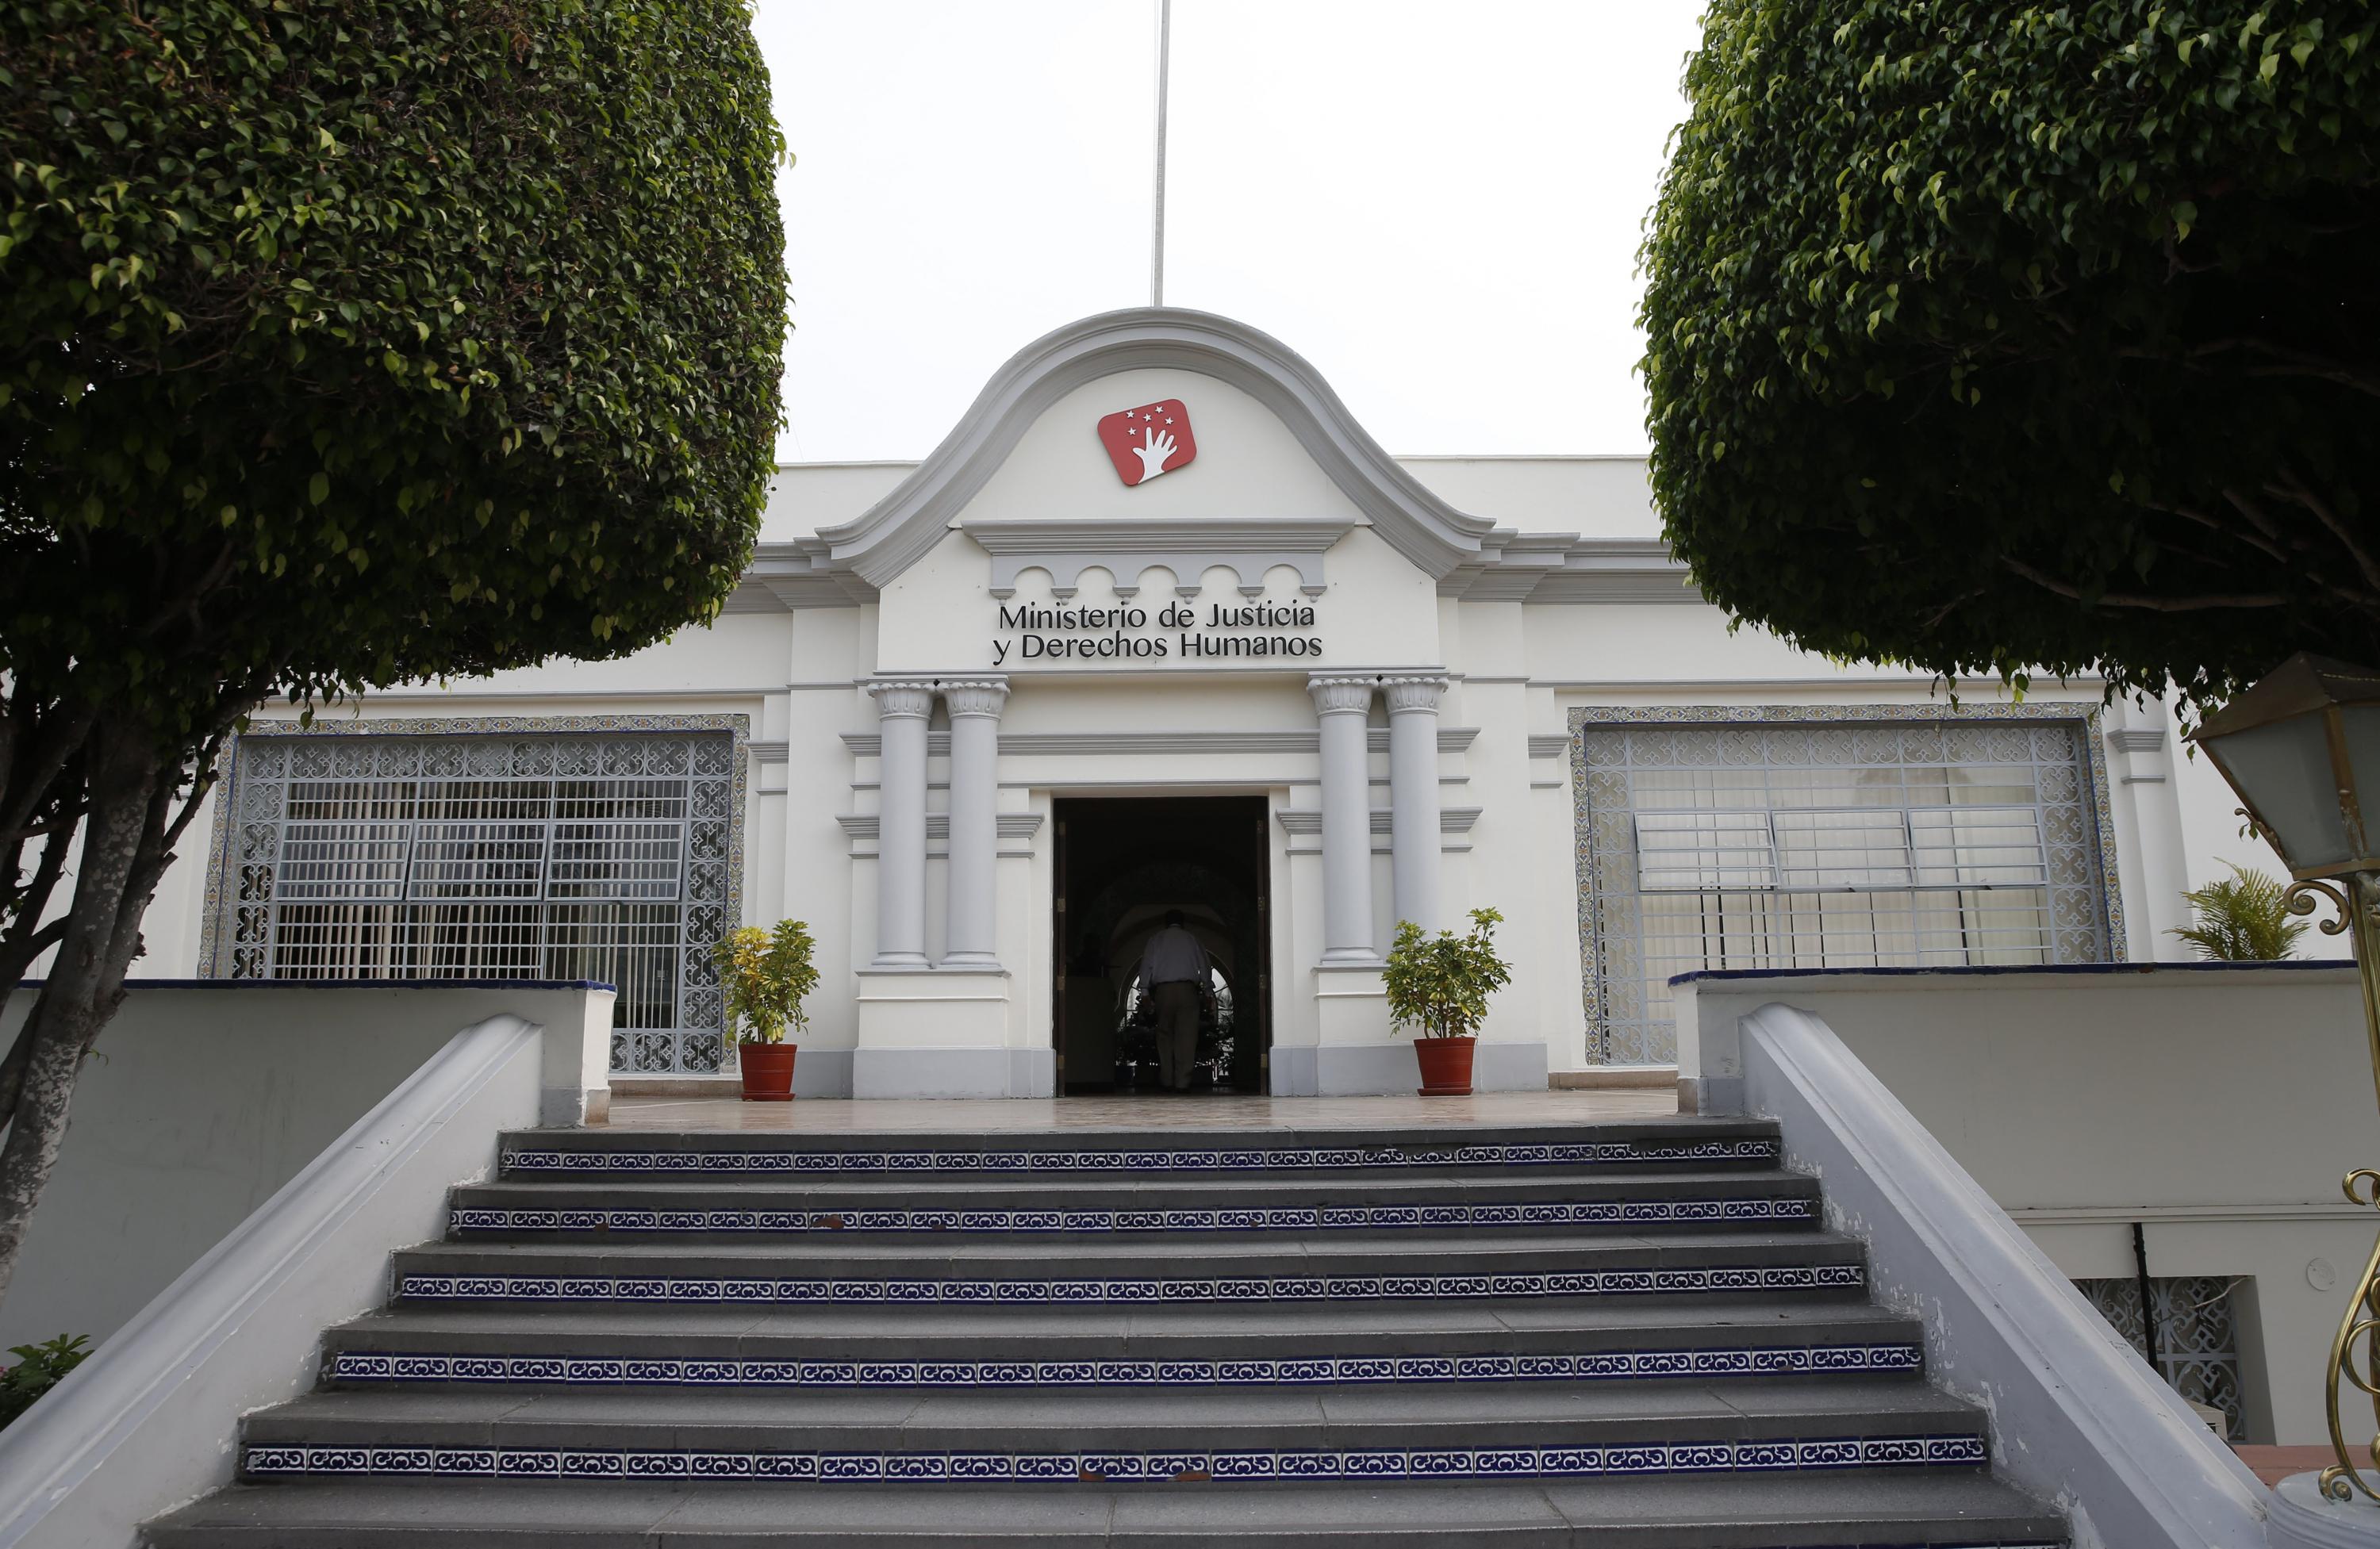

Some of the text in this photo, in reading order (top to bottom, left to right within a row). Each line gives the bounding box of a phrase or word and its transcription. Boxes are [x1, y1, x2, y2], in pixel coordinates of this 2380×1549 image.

[1000, 599, 1315, 629] Ministerio de Justicia
[992, 630, 1322, 666] y Derechos Humanos
